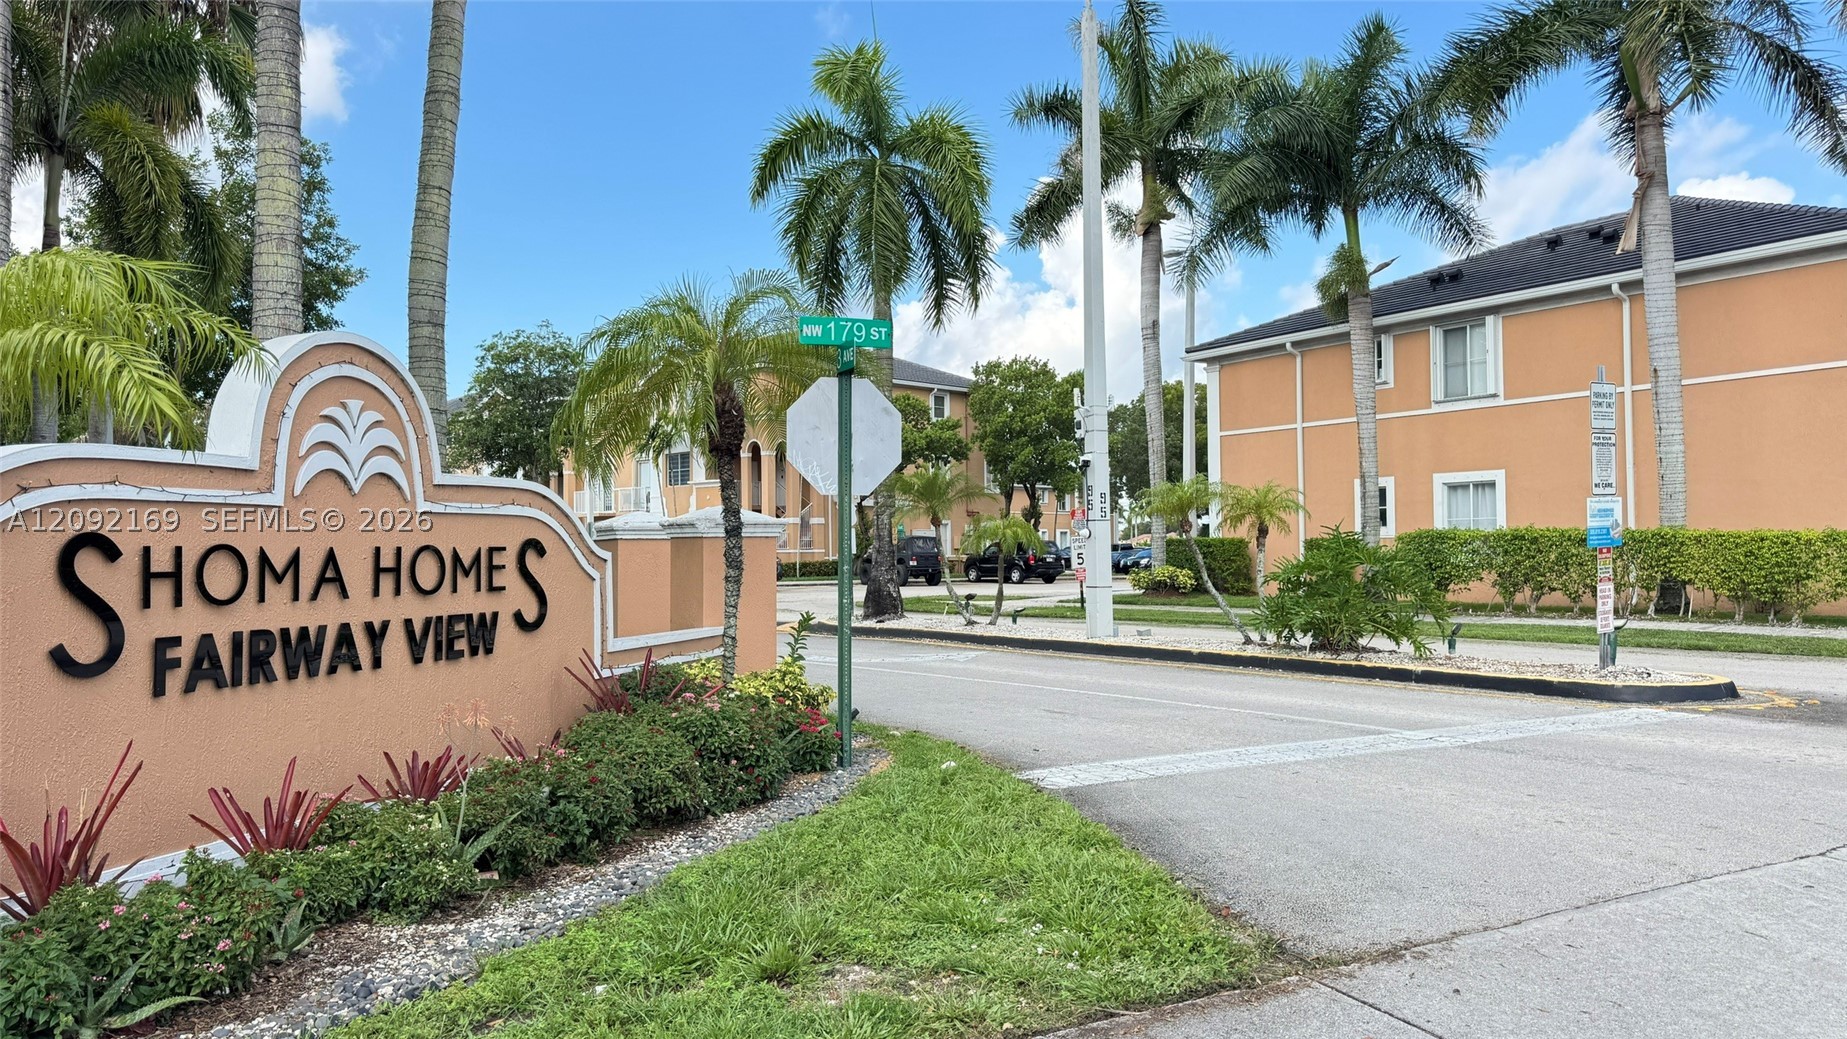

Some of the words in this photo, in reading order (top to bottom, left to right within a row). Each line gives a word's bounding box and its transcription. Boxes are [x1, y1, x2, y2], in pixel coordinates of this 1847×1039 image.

[802, 324, 823, 337] NW
[826, 320, 866, 342] 179
[870, 327, 888, 340] ST
[843, 347, 854, 363] AVE
[1592, 400, 1605, 409] PERMIT
[1605, 401, 1615, 409] ONLY
[1593, 391, 1608, 400] PARKING
[1100, 492, 1106, 518] 95
[1077, 552, 1084, 565] 5
[49, 531, 350, 679] SHOMA
[371, 537, 549, 632] HOMES
[153, 619, 391, 698] FAIRWAY
[404, 611, 499, 664] VIEW
